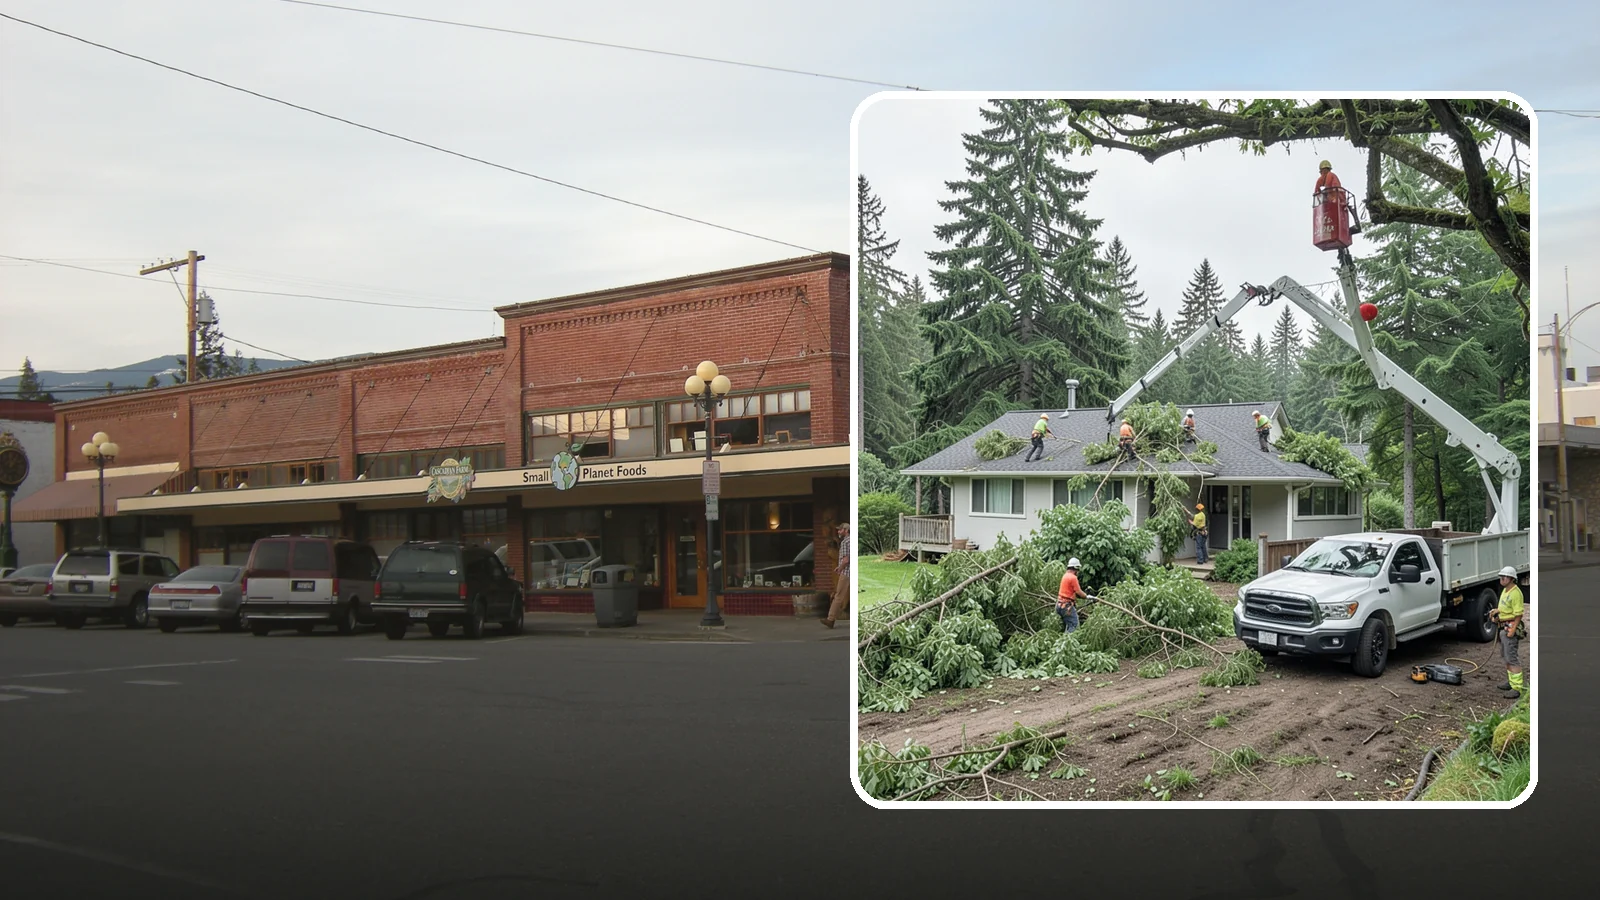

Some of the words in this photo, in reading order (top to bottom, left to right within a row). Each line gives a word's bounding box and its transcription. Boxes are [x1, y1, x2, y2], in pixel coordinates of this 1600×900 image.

[456, 465, 469, 474] FARM
[523, 471, 549, 482] Small
[582, 467, 614, 479] Planet
[616, 464, 647, 477] Foods
